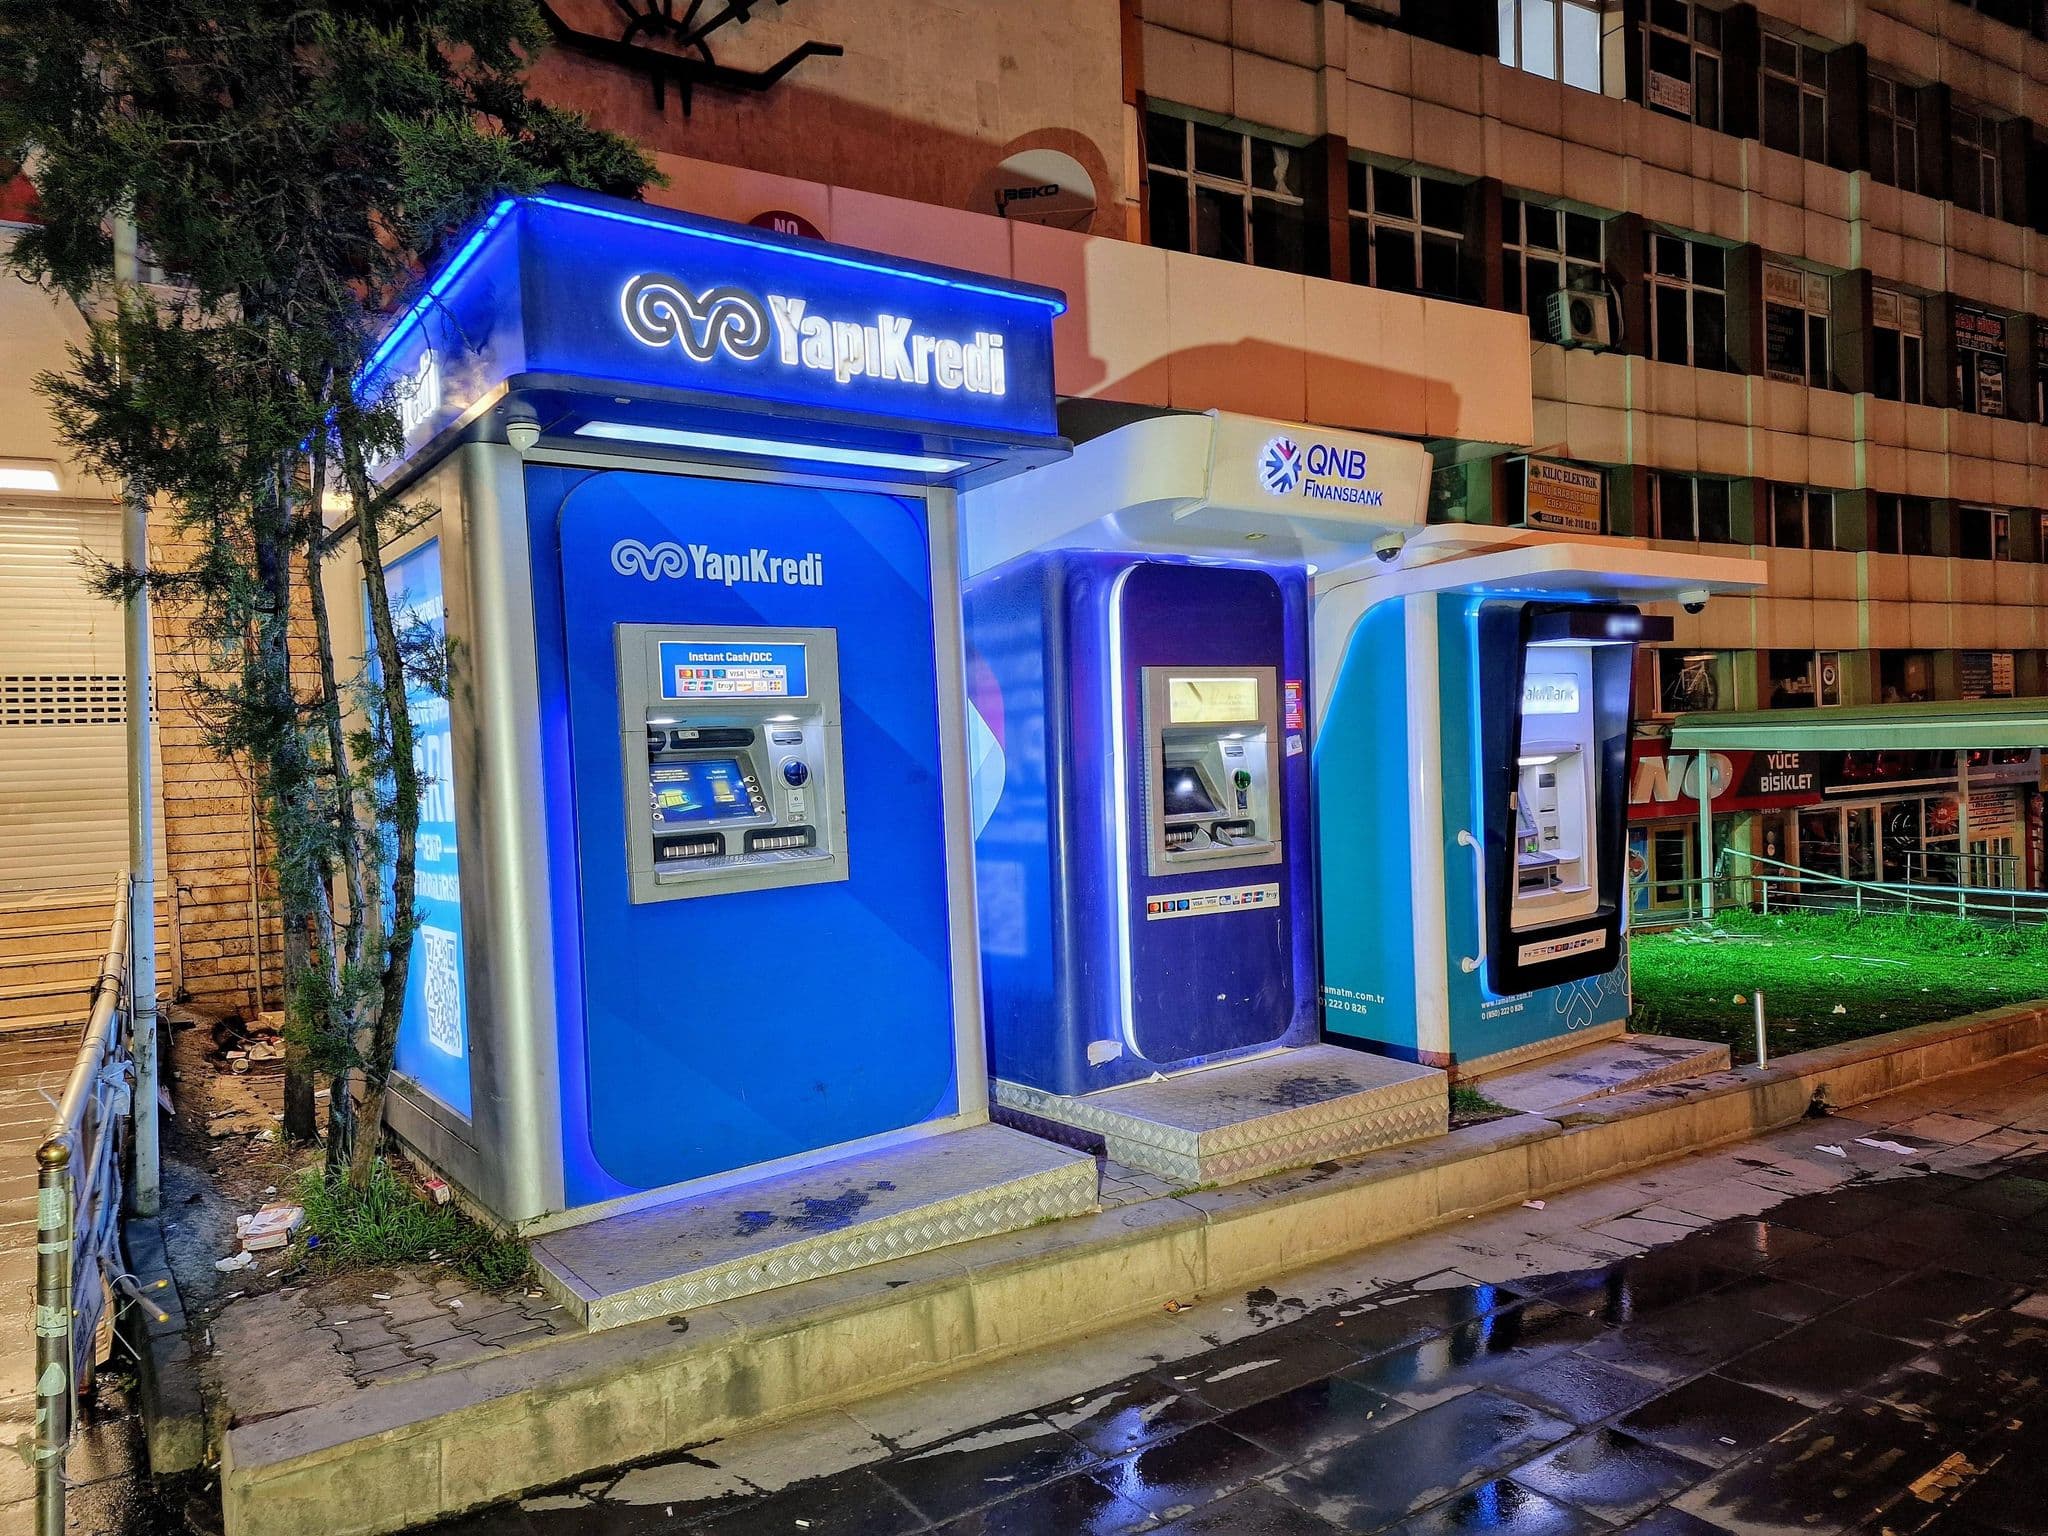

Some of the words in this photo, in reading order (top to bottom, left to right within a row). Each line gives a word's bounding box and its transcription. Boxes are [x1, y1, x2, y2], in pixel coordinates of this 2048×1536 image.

[1004, 184, 1059, 200] BEKO
[767, 294, 1007, 395] YapıKredi
[1307, 444, 1366, 480] QNB
[688, 544, 823, 586] YapıKredi
[689, 651, 725, 662] Instant
[726, 651, 773, 663] Cash/DCC
[1768, 751, 1800, 770] YÜCE
[1761, 772, 1813, 793] BİSİKLET
[1328, 998, 1343, 1010] 222
[1344, 1001, 1350, 1011] 0
[1351, 1004, 1367, 1015] 826
[1481, 1012, 1486, 1020] 0
